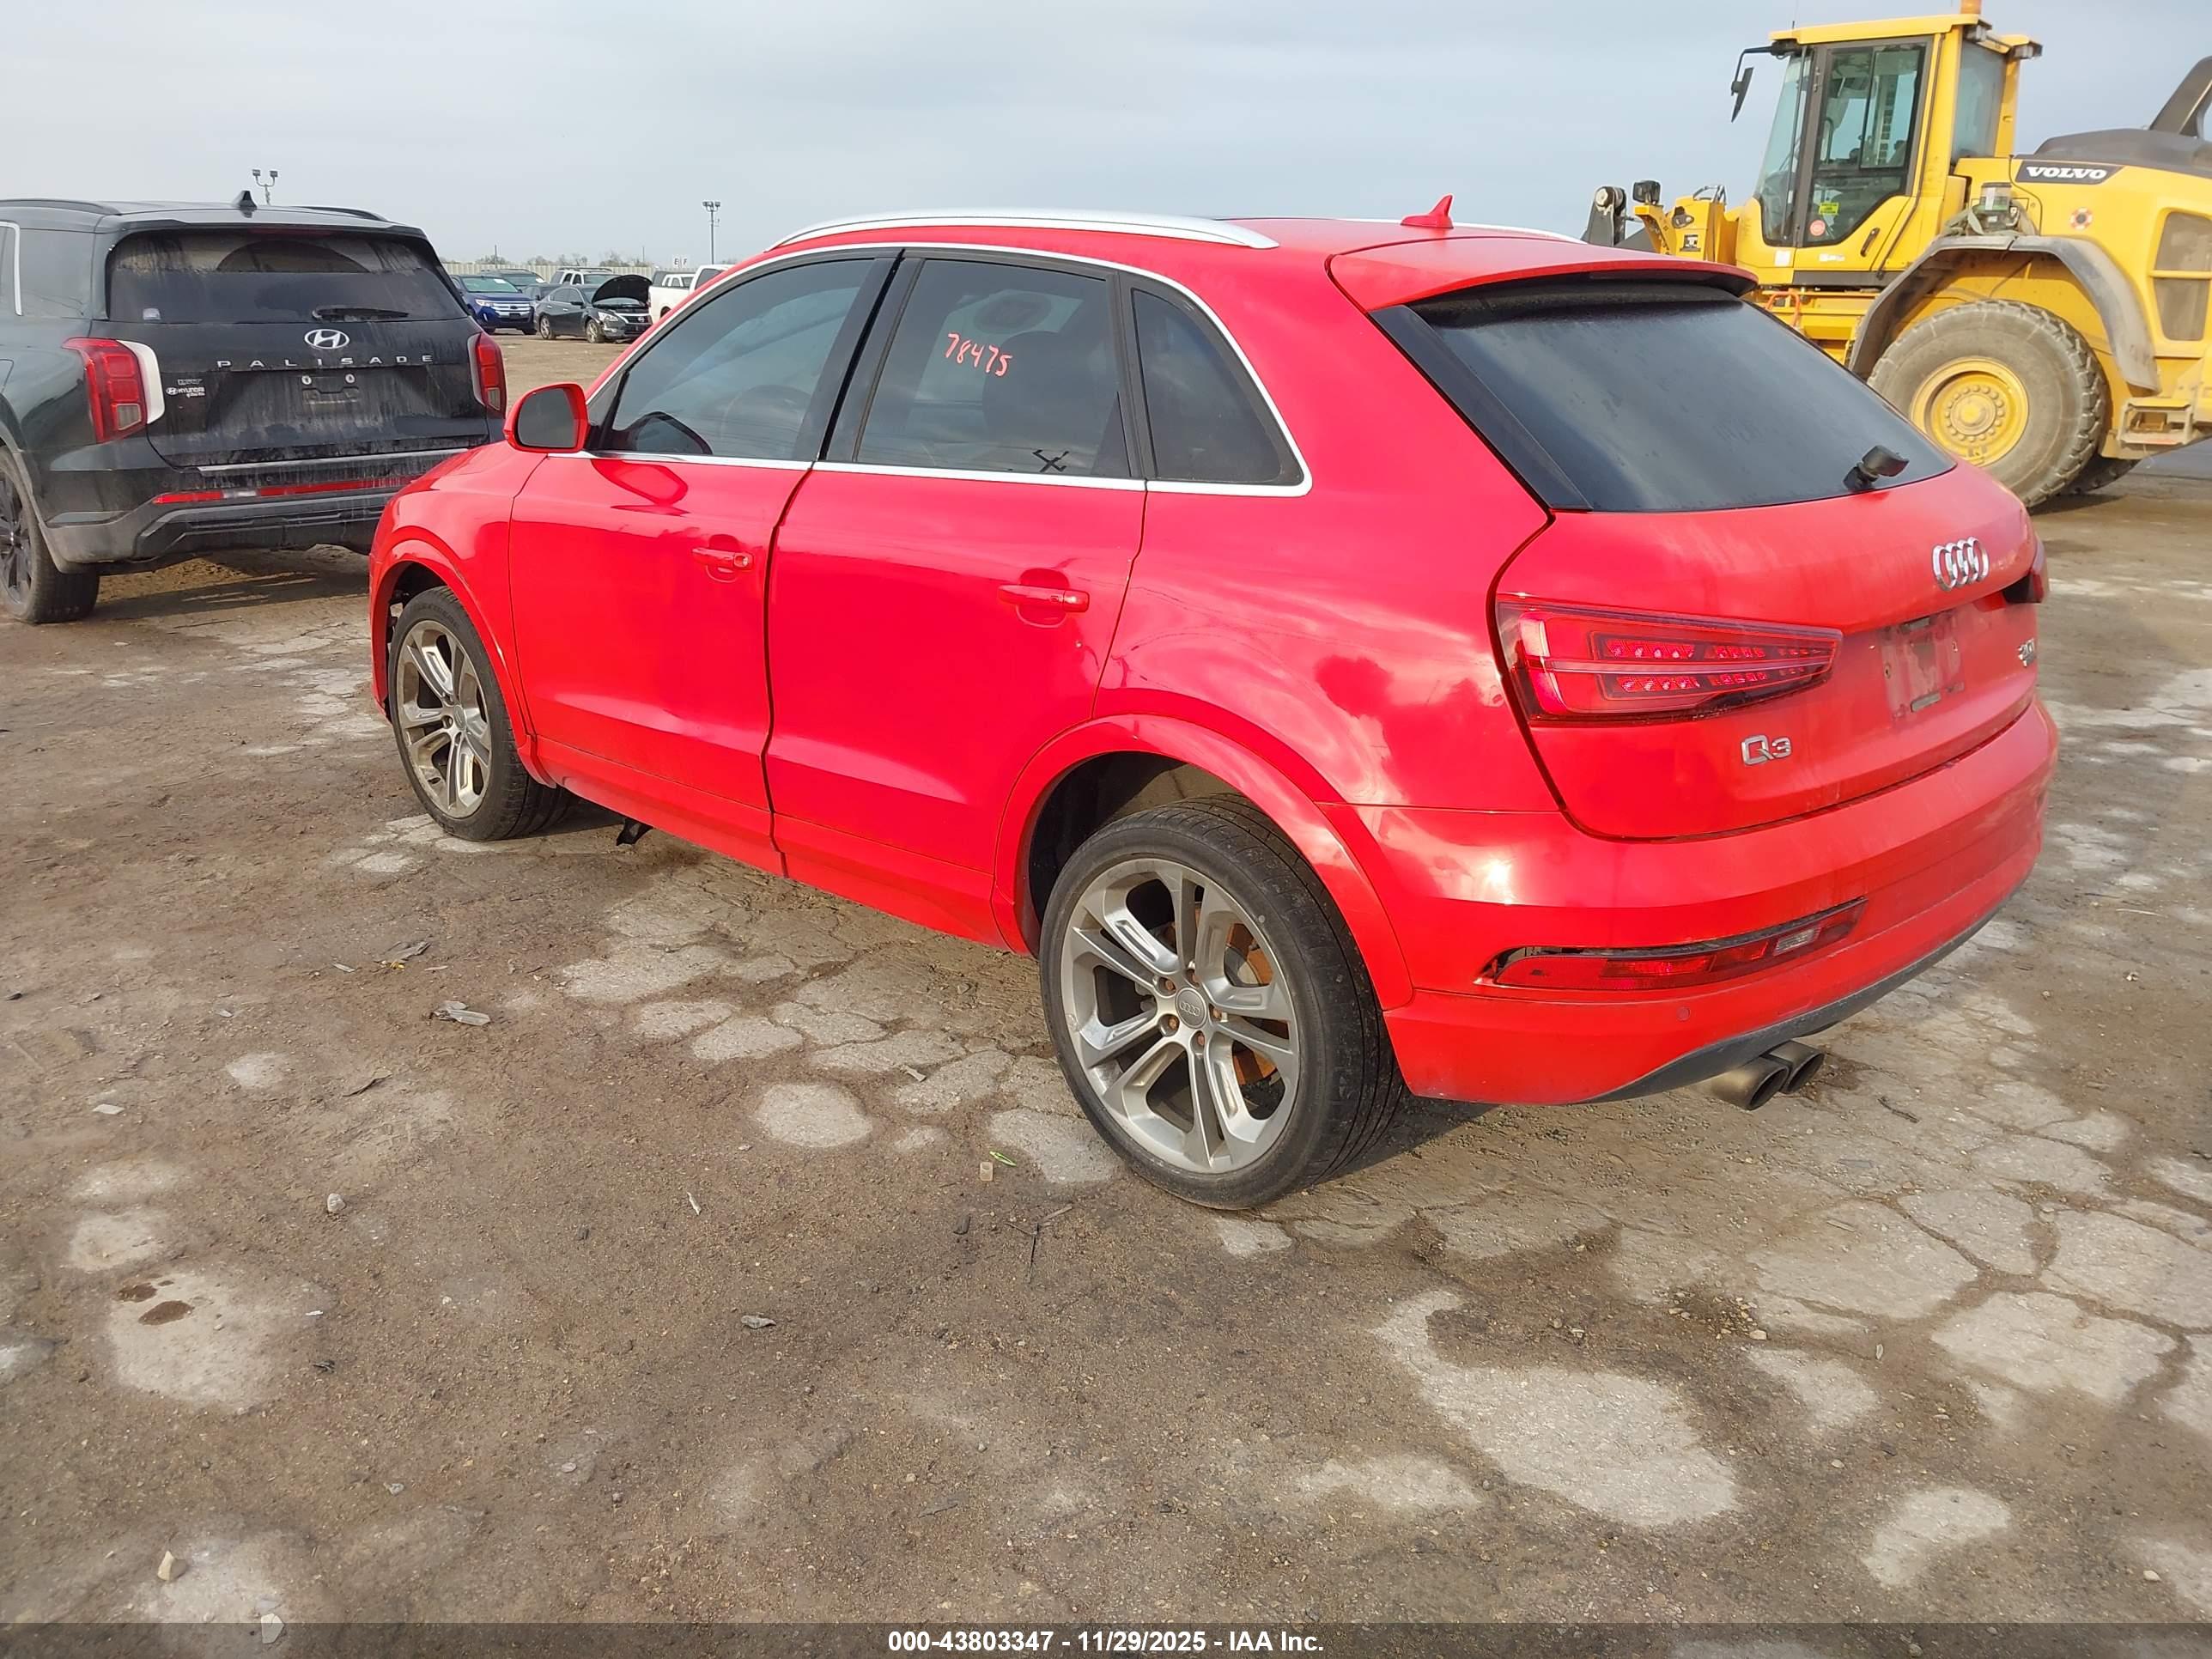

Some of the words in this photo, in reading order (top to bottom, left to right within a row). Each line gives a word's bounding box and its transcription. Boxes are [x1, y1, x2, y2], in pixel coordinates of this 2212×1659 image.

[2027, 167, 2107, 179] VOLVO
[217, 355, 433, 368] PALISADE
[945, 332, 1013, 376] 78475
[1741, 735, 1791, 765] Q3
